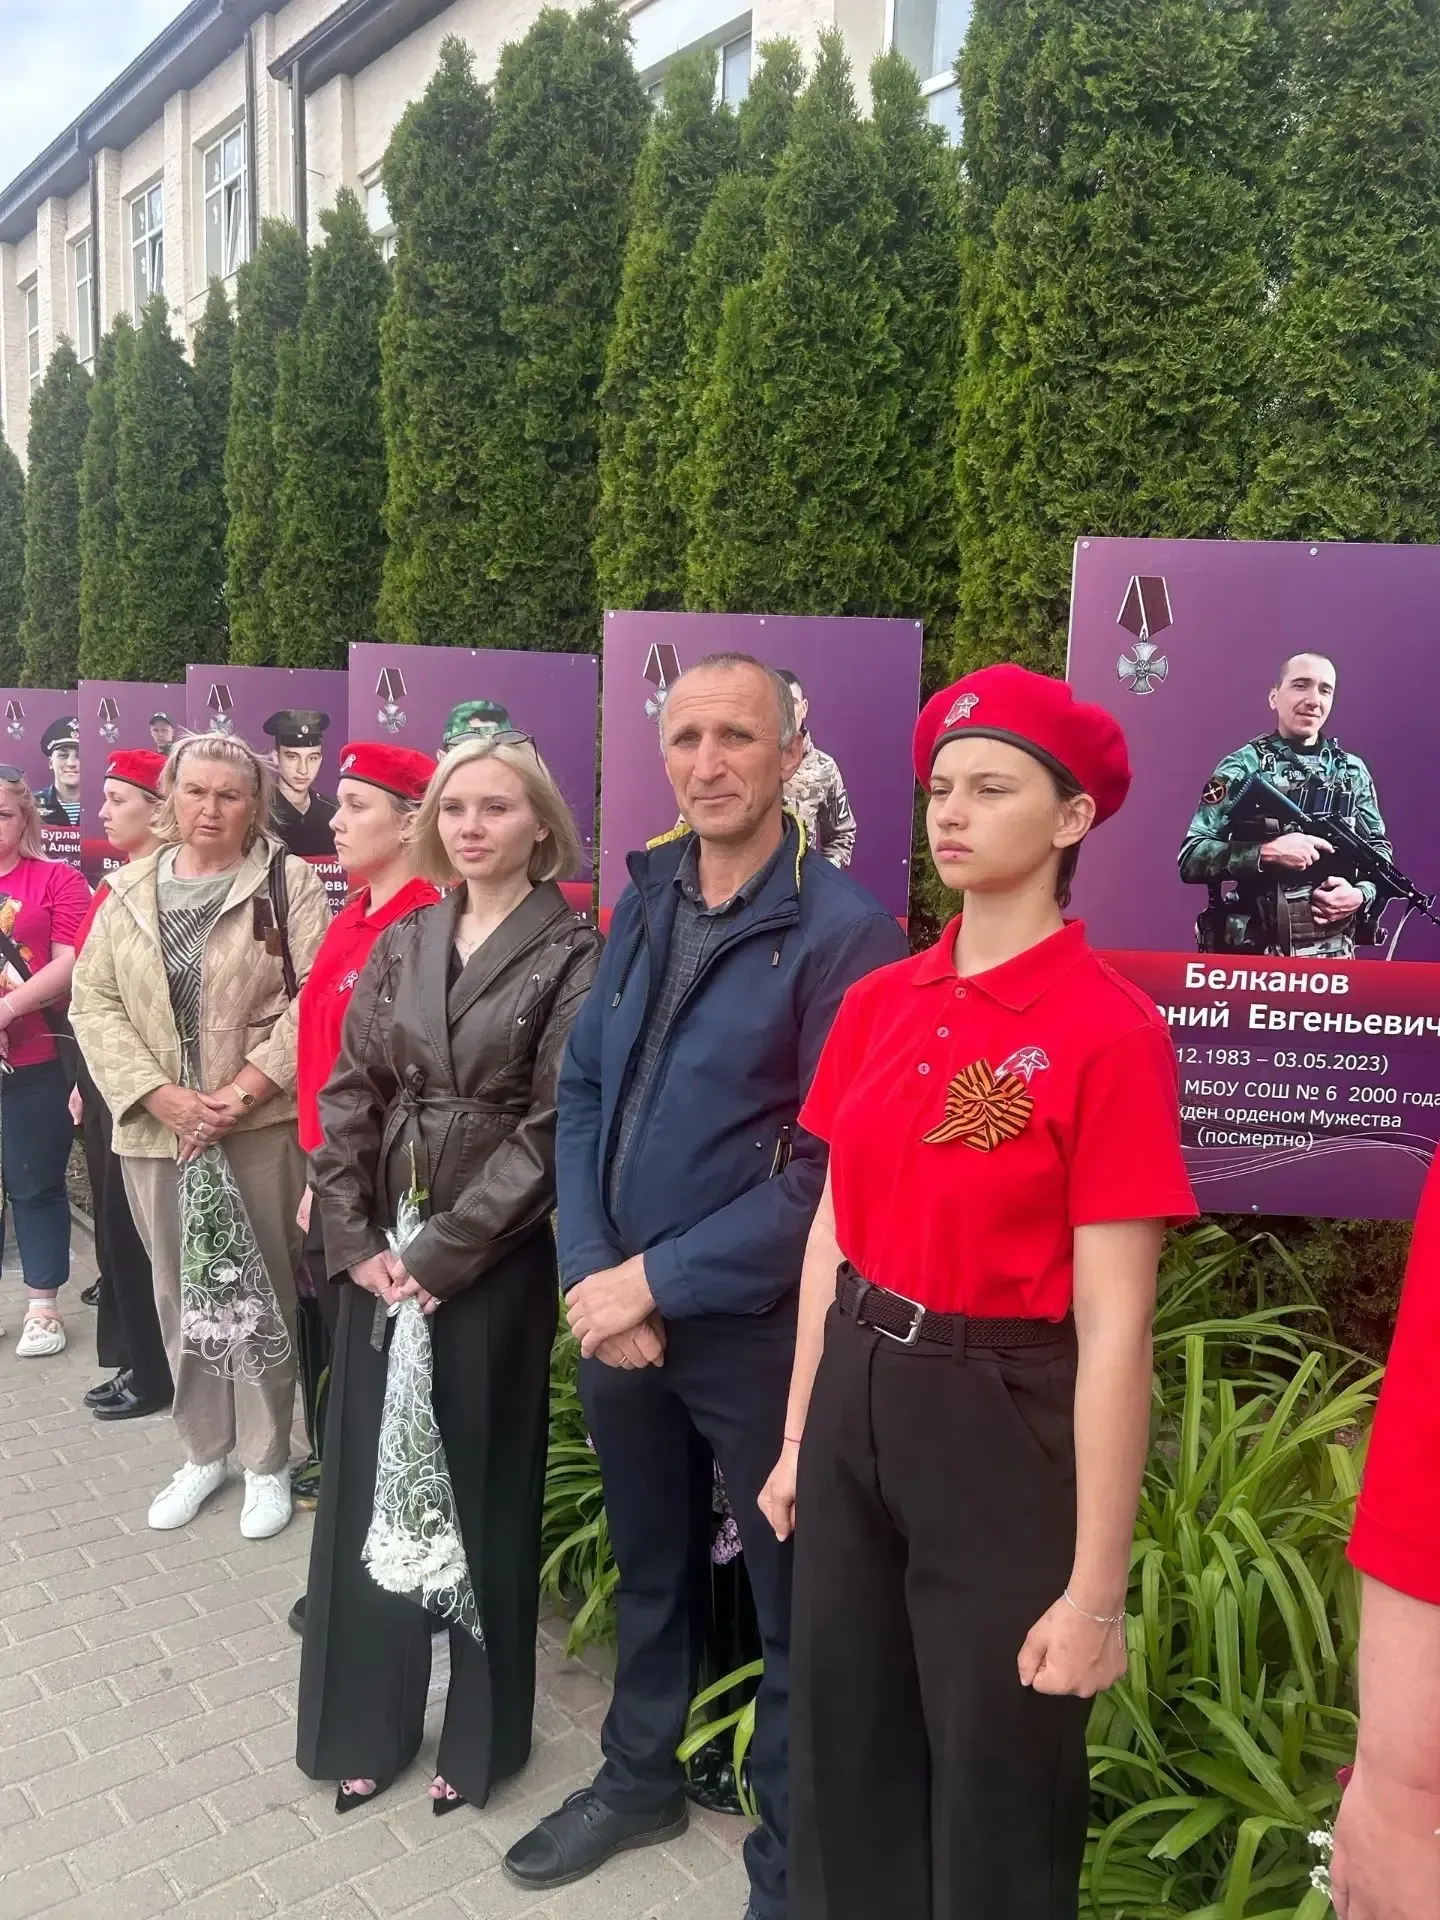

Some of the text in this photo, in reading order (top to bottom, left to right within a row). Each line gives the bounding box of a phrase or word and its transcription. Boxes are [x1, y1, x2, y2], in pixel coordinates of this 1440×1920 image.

[312, 861, 342, 874] кий
[1185, 962, 1349, 995] Белканов
[1248, 1003, 1440, 1037] Евгеньевич
[1273, 1051, 1389, 1076] 03.05.2023)
[1185, 1079, 1440, 1107] МБОУ СОШ № 6 2000 года
[1225, 1108, 1306, 1125] орденом
[1310, 1110, 1402, 1128] Мужества
[1197, 1126, 1314, 1151] (посмертно)
